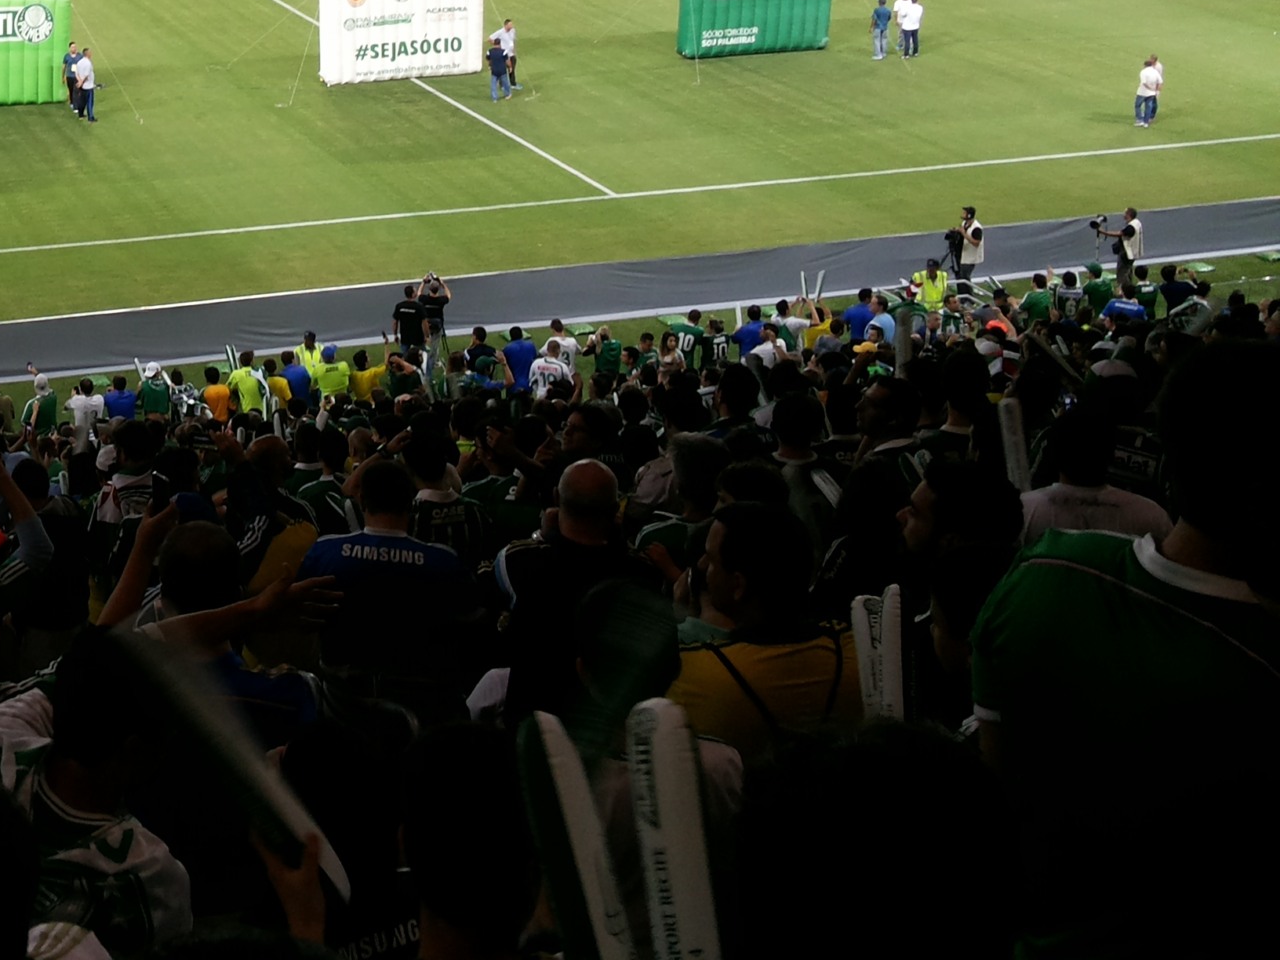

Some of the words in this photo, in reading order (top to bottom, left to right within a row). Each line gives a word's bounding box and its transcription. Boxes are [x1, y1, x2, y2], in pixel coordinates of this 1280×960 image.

[355, 33, 463, 62] #SEJASÓCIO
[678, 331, 695, 352] 10
[713, 343, 728, 361] 10
[341, 542, 425, 566] SAMSUNG
